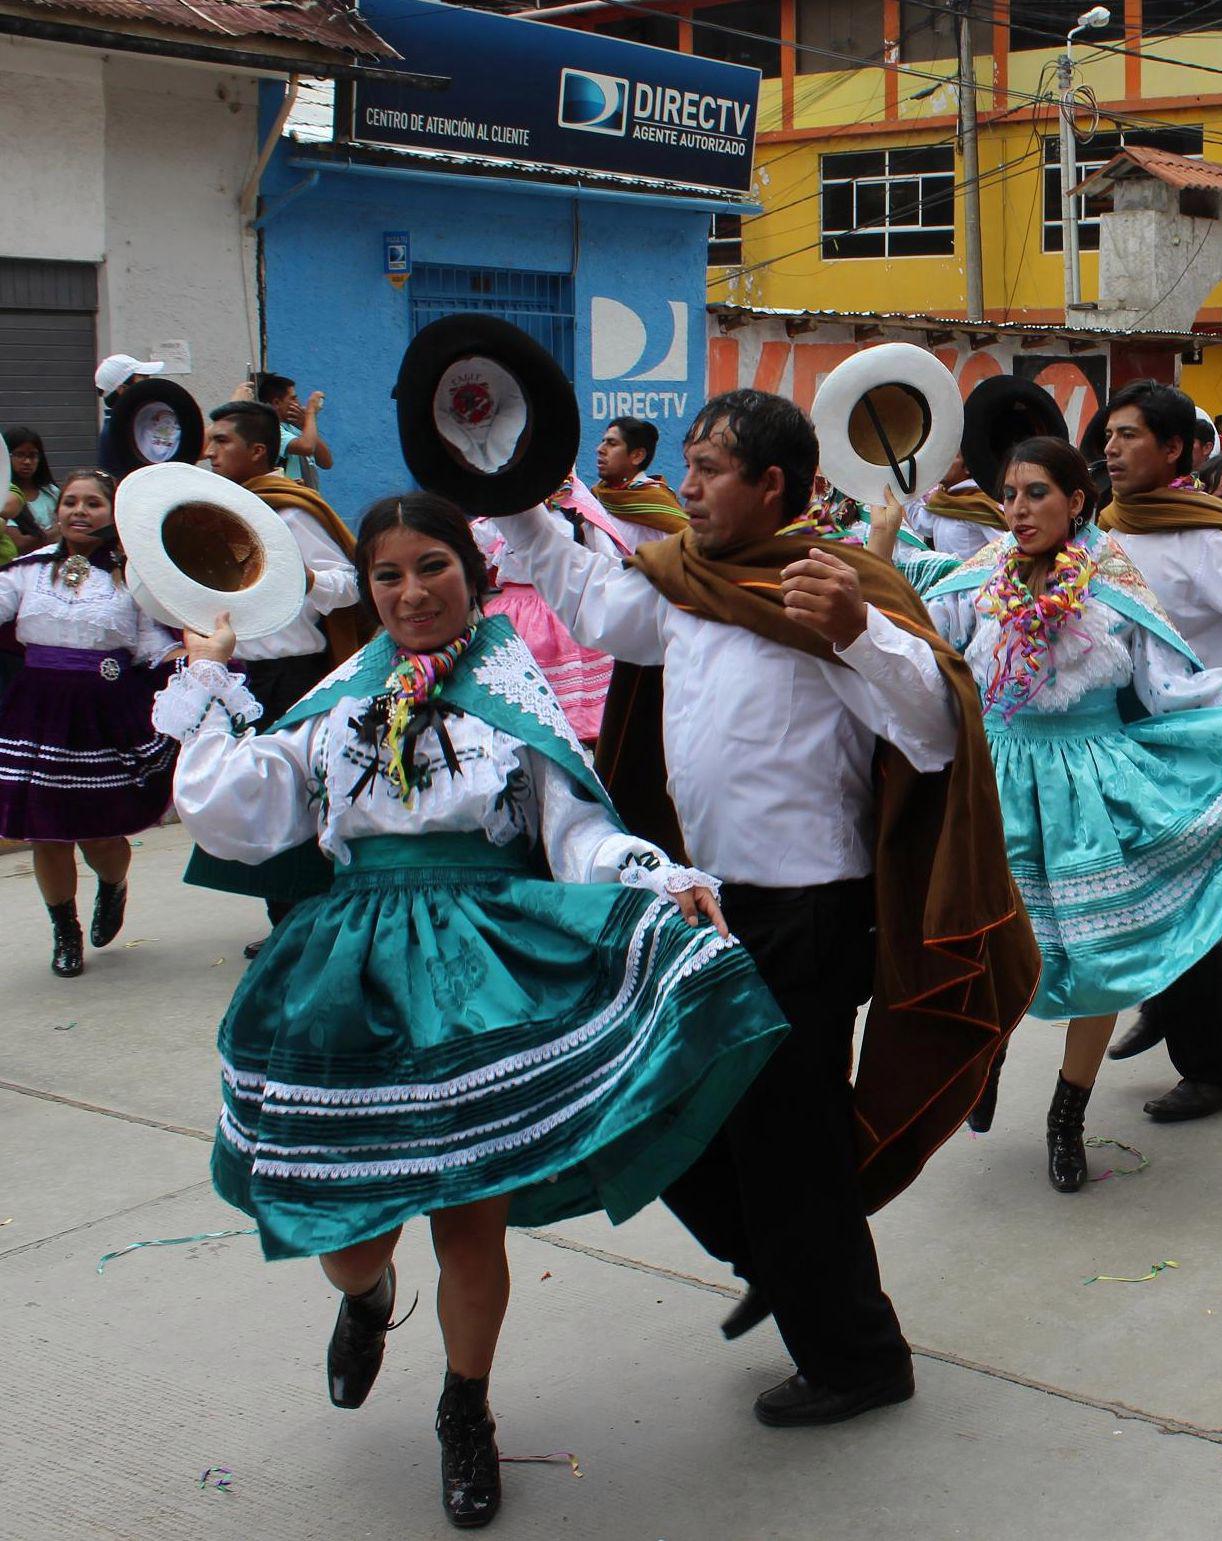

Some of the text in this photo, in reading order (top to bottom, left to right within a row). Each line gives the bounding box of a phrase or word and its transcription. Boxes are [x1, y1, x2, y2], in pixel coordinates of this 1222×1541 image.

[366, 107, 530, 146] CENTRO DE ATENCIÓN AL CLIENTE
[633, 82, 751, 136] DIRECTV
[633, 125, 746, 156] AGENTE AUTORIZADO
[591, 391, 688, 420] DIRECTV
